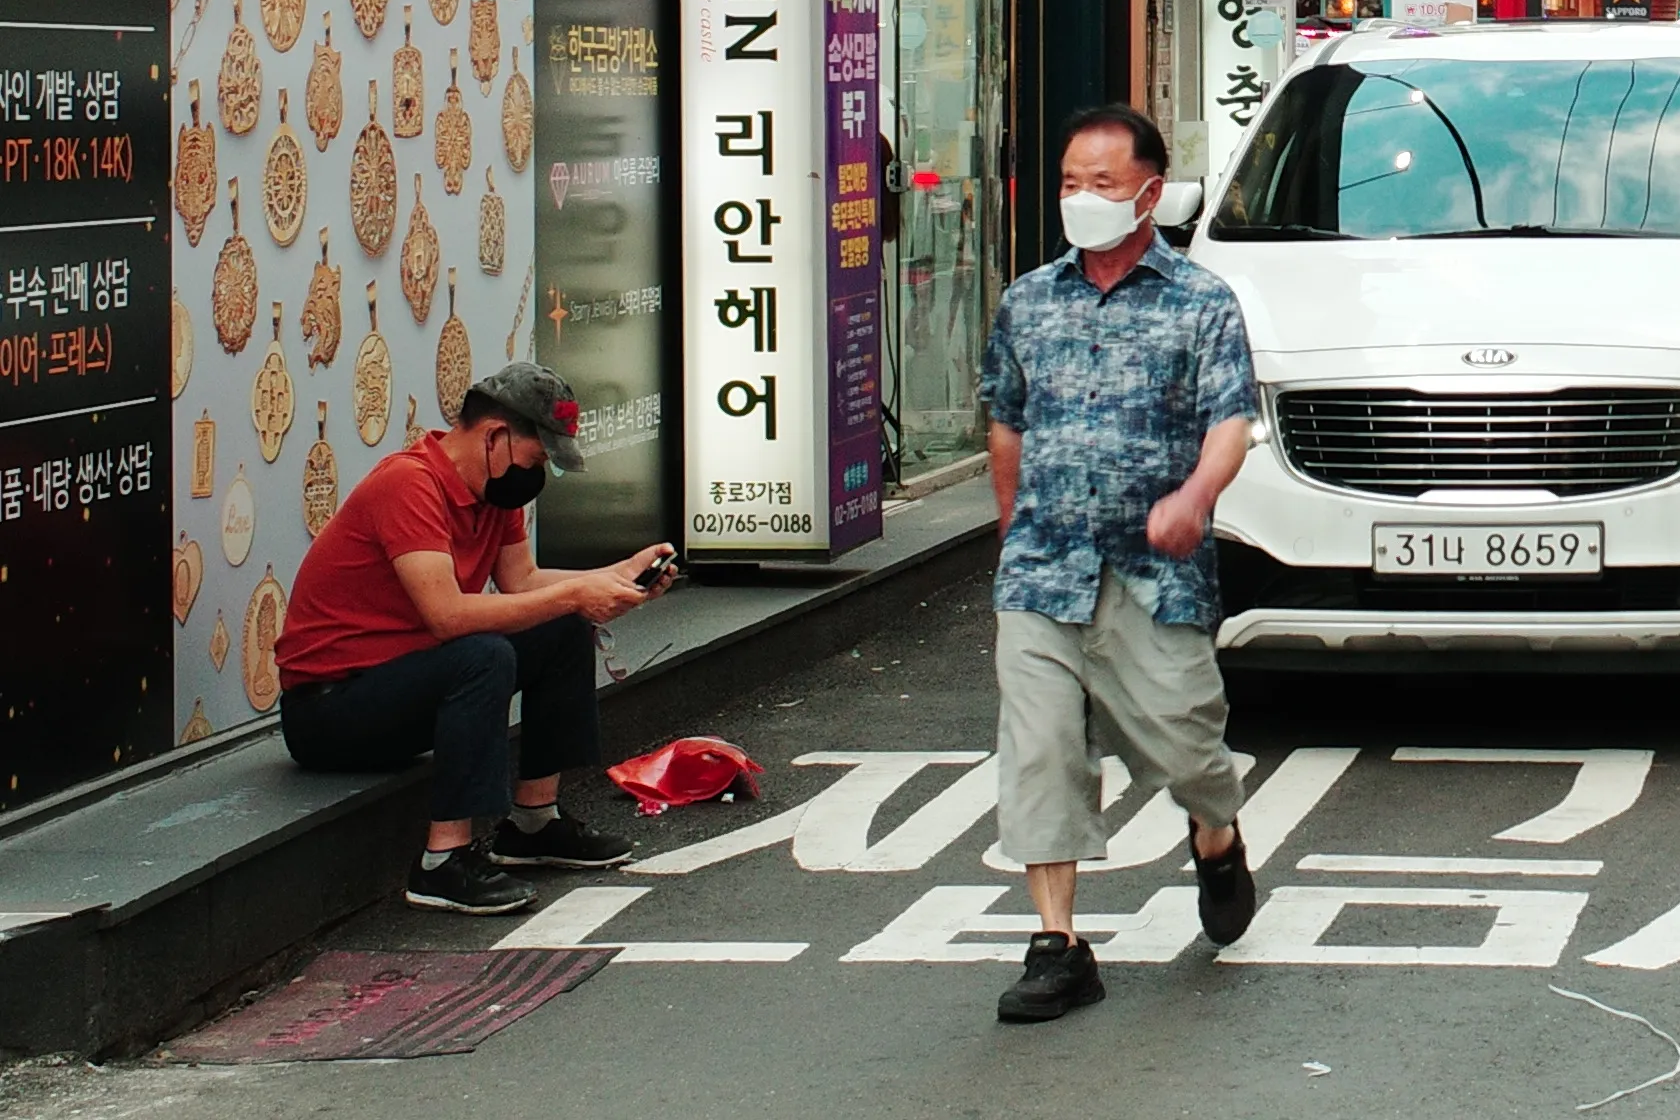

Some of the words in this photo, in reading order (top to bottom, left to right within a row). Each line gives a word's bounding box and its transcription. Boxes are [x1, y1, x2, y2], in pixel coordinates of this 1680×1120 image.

[1604, 6, 1648, 18] SAPPORO
[50, 261, 89, 315] 판매
[93, 258, 131, 311] 상담
[713, 109, 783, 442] 리안헤어
[1470, 348, 1508, 364] KIA
[76, 446, 114, 515] 생산
[116, 441, 154, 505] 상담
[708, 482, 793, 506] 종로3가점
[692, 513, 813, 536] 02)765-0188
[1395, 533, 1465, 567] 31나
[1485, 533, 1581, 567] 8659
